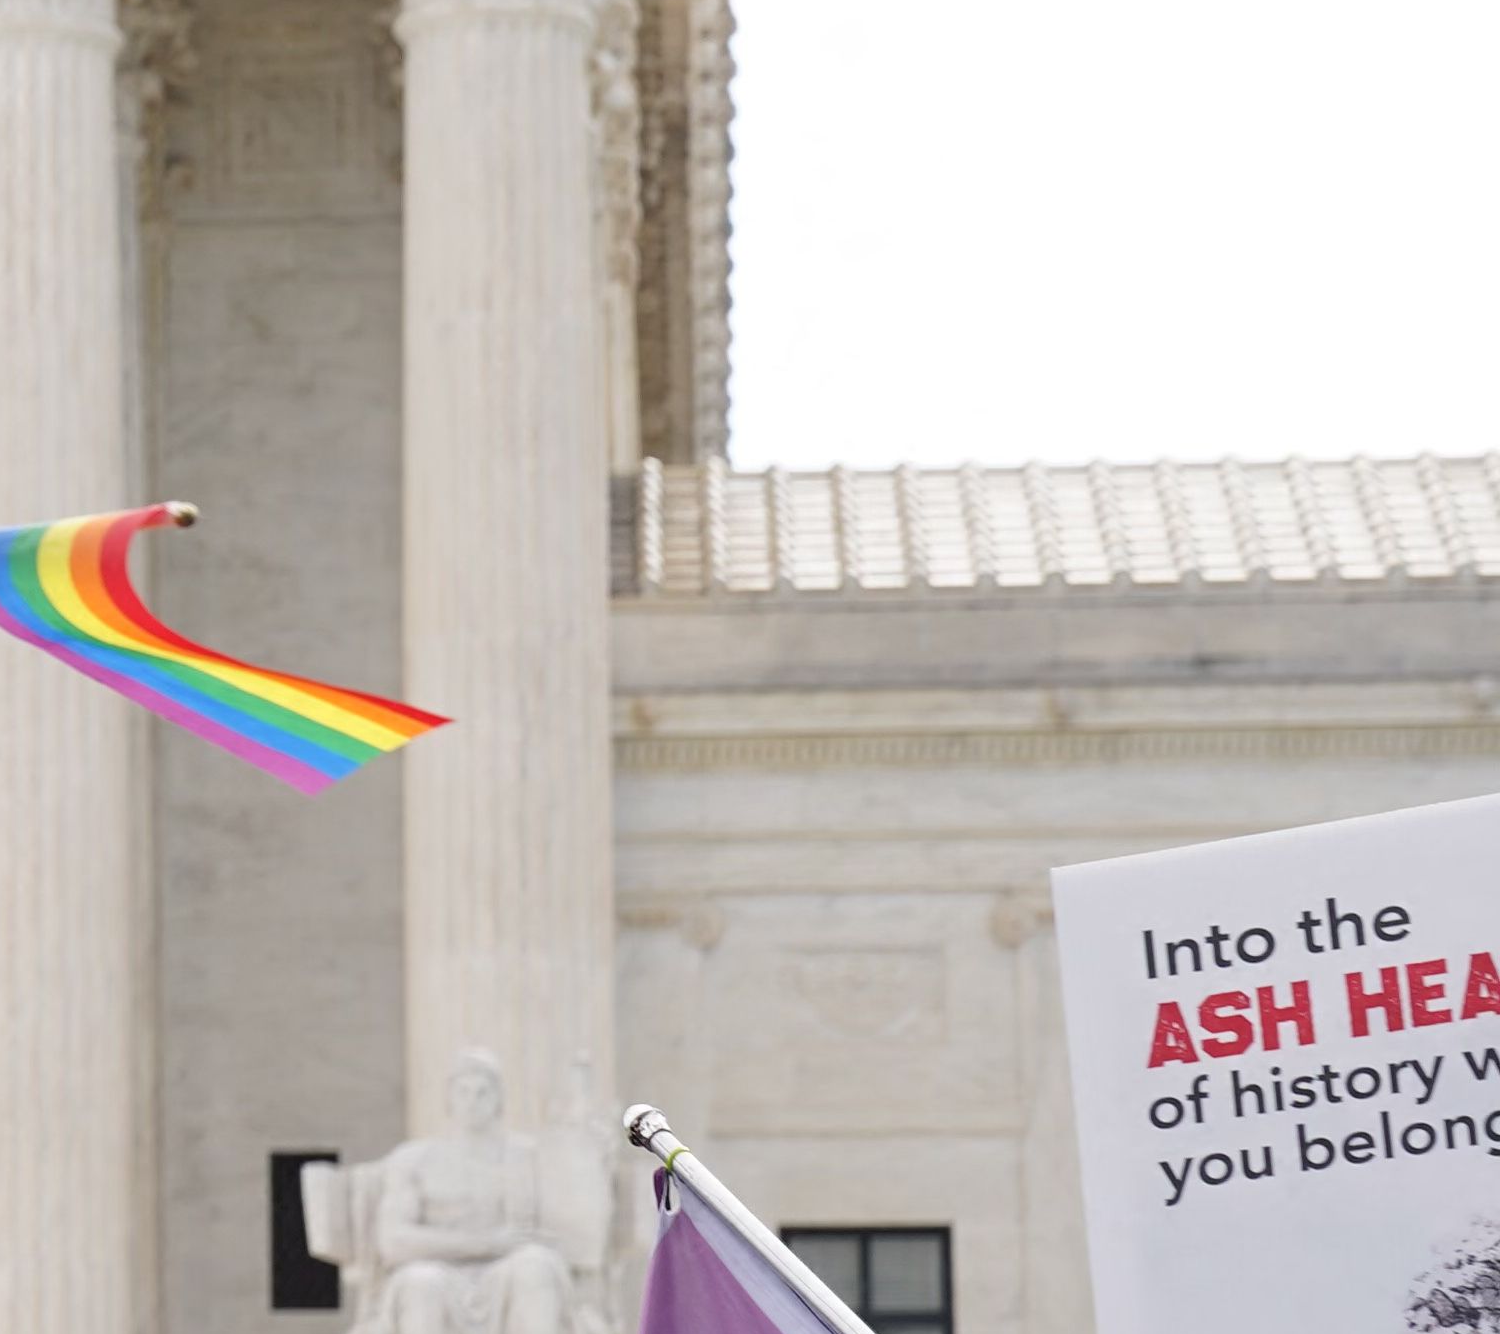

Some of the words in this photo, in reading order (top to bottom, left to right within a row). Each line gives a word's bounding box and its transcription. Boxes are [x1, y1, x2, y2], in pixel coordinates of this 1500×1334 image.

[1143, 926, 1276, 980] Into
[1296, 897, 1412, 954] the
[1146, 979, 1316, 1069] ASH
[1148, 1073, 1210, 1130] of
[1231, 1055, 1444, 1118] history
[1159, 1146, 1275, 1207] you
